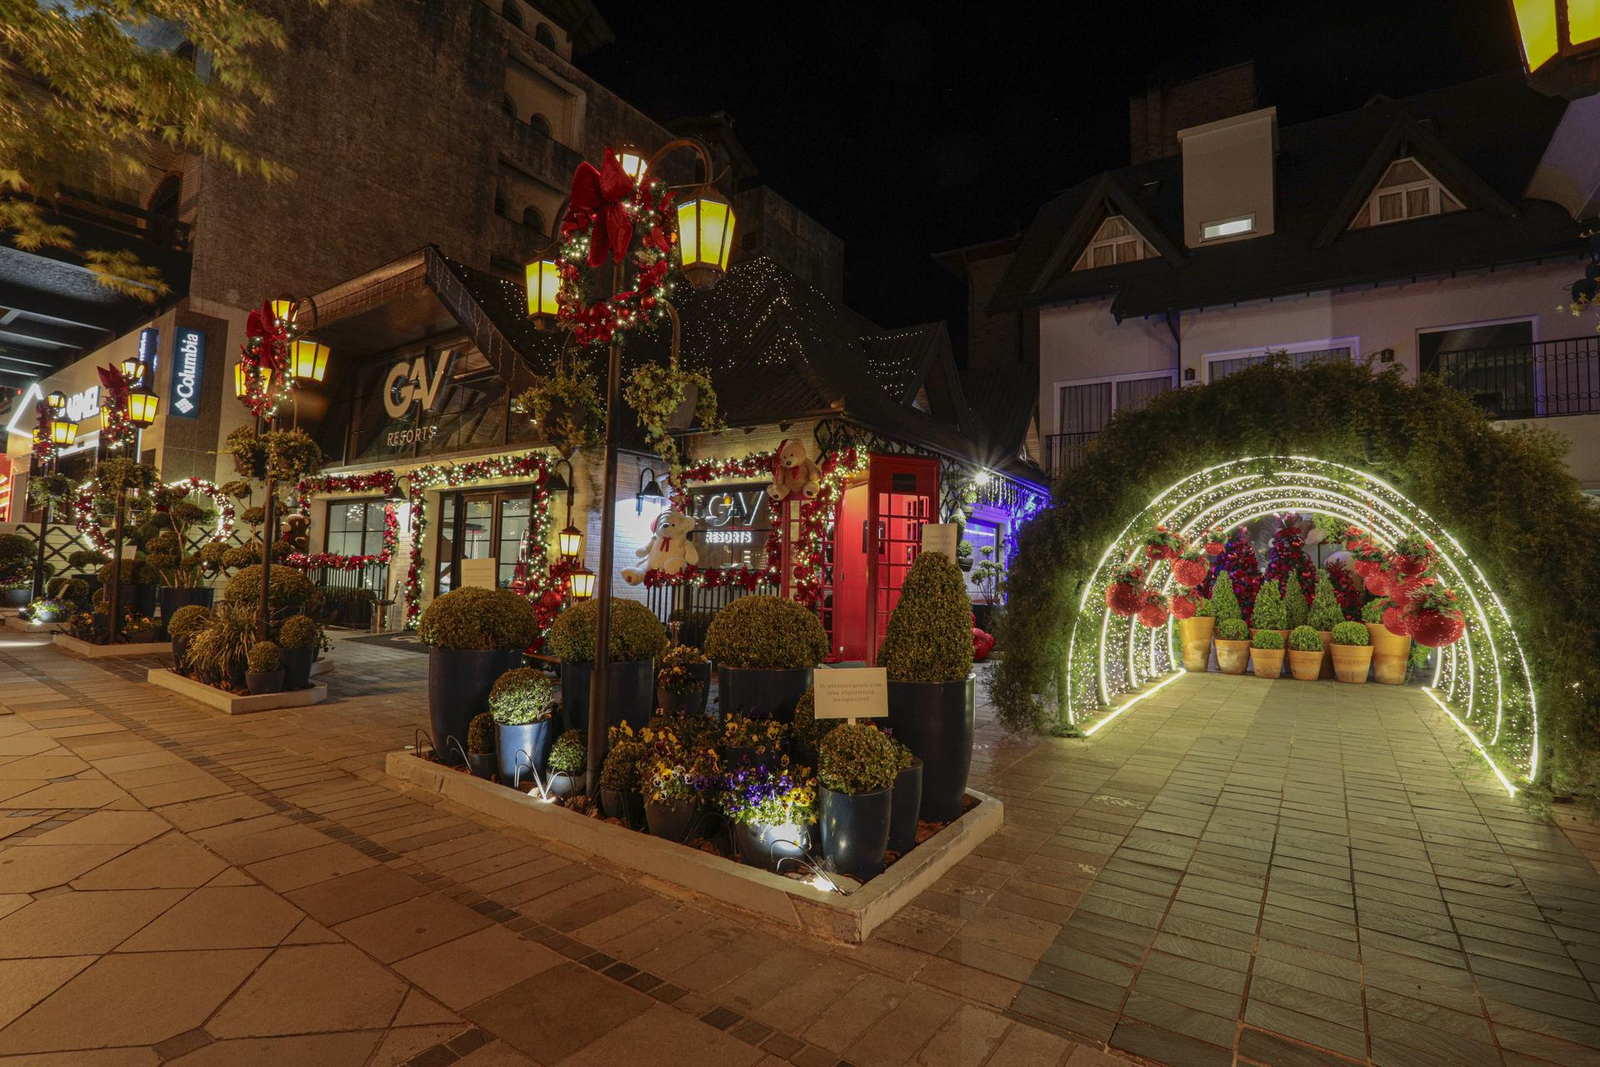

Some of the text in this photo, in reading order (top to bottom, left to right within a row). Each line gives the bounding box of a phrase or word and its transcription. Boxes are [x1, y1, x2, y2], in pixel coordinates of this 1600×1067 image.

[177, 333, 199, 399] Columbia
[383, 349, 452, 418] GAV
[387, 425, 436, 446] RESORTS
[705, 531, 752, 544] RESORTS
